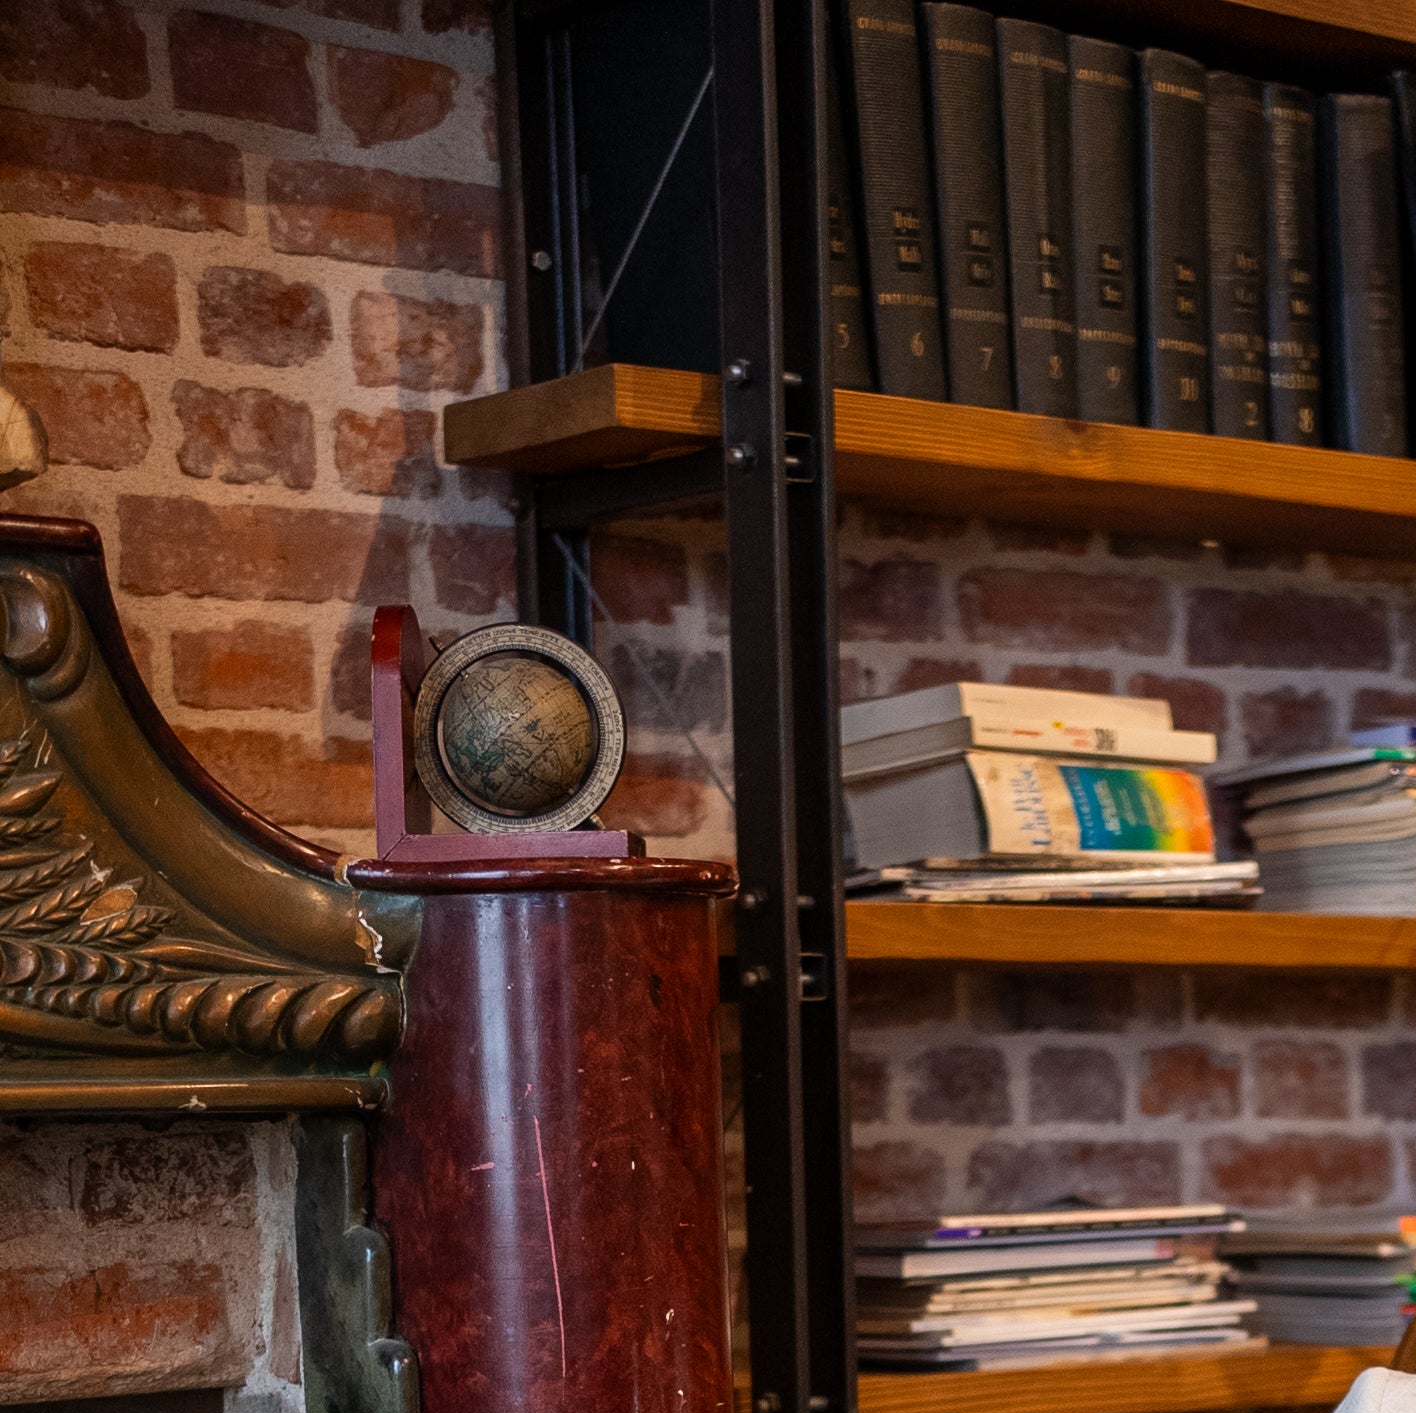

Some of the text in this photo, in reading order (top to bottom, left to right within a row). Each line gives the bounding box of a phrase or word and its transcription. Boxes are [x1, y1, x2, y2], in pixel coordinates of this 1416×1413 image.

[837, 322, 851, 350] 5
[910, 331, 925, 357] 6
[980, 346, 994, 371] 7
[494, 627, 516, 636] ZONA
[566, 645, 587, 662] ZONA
[611, 709, 620, 733] ZONA
